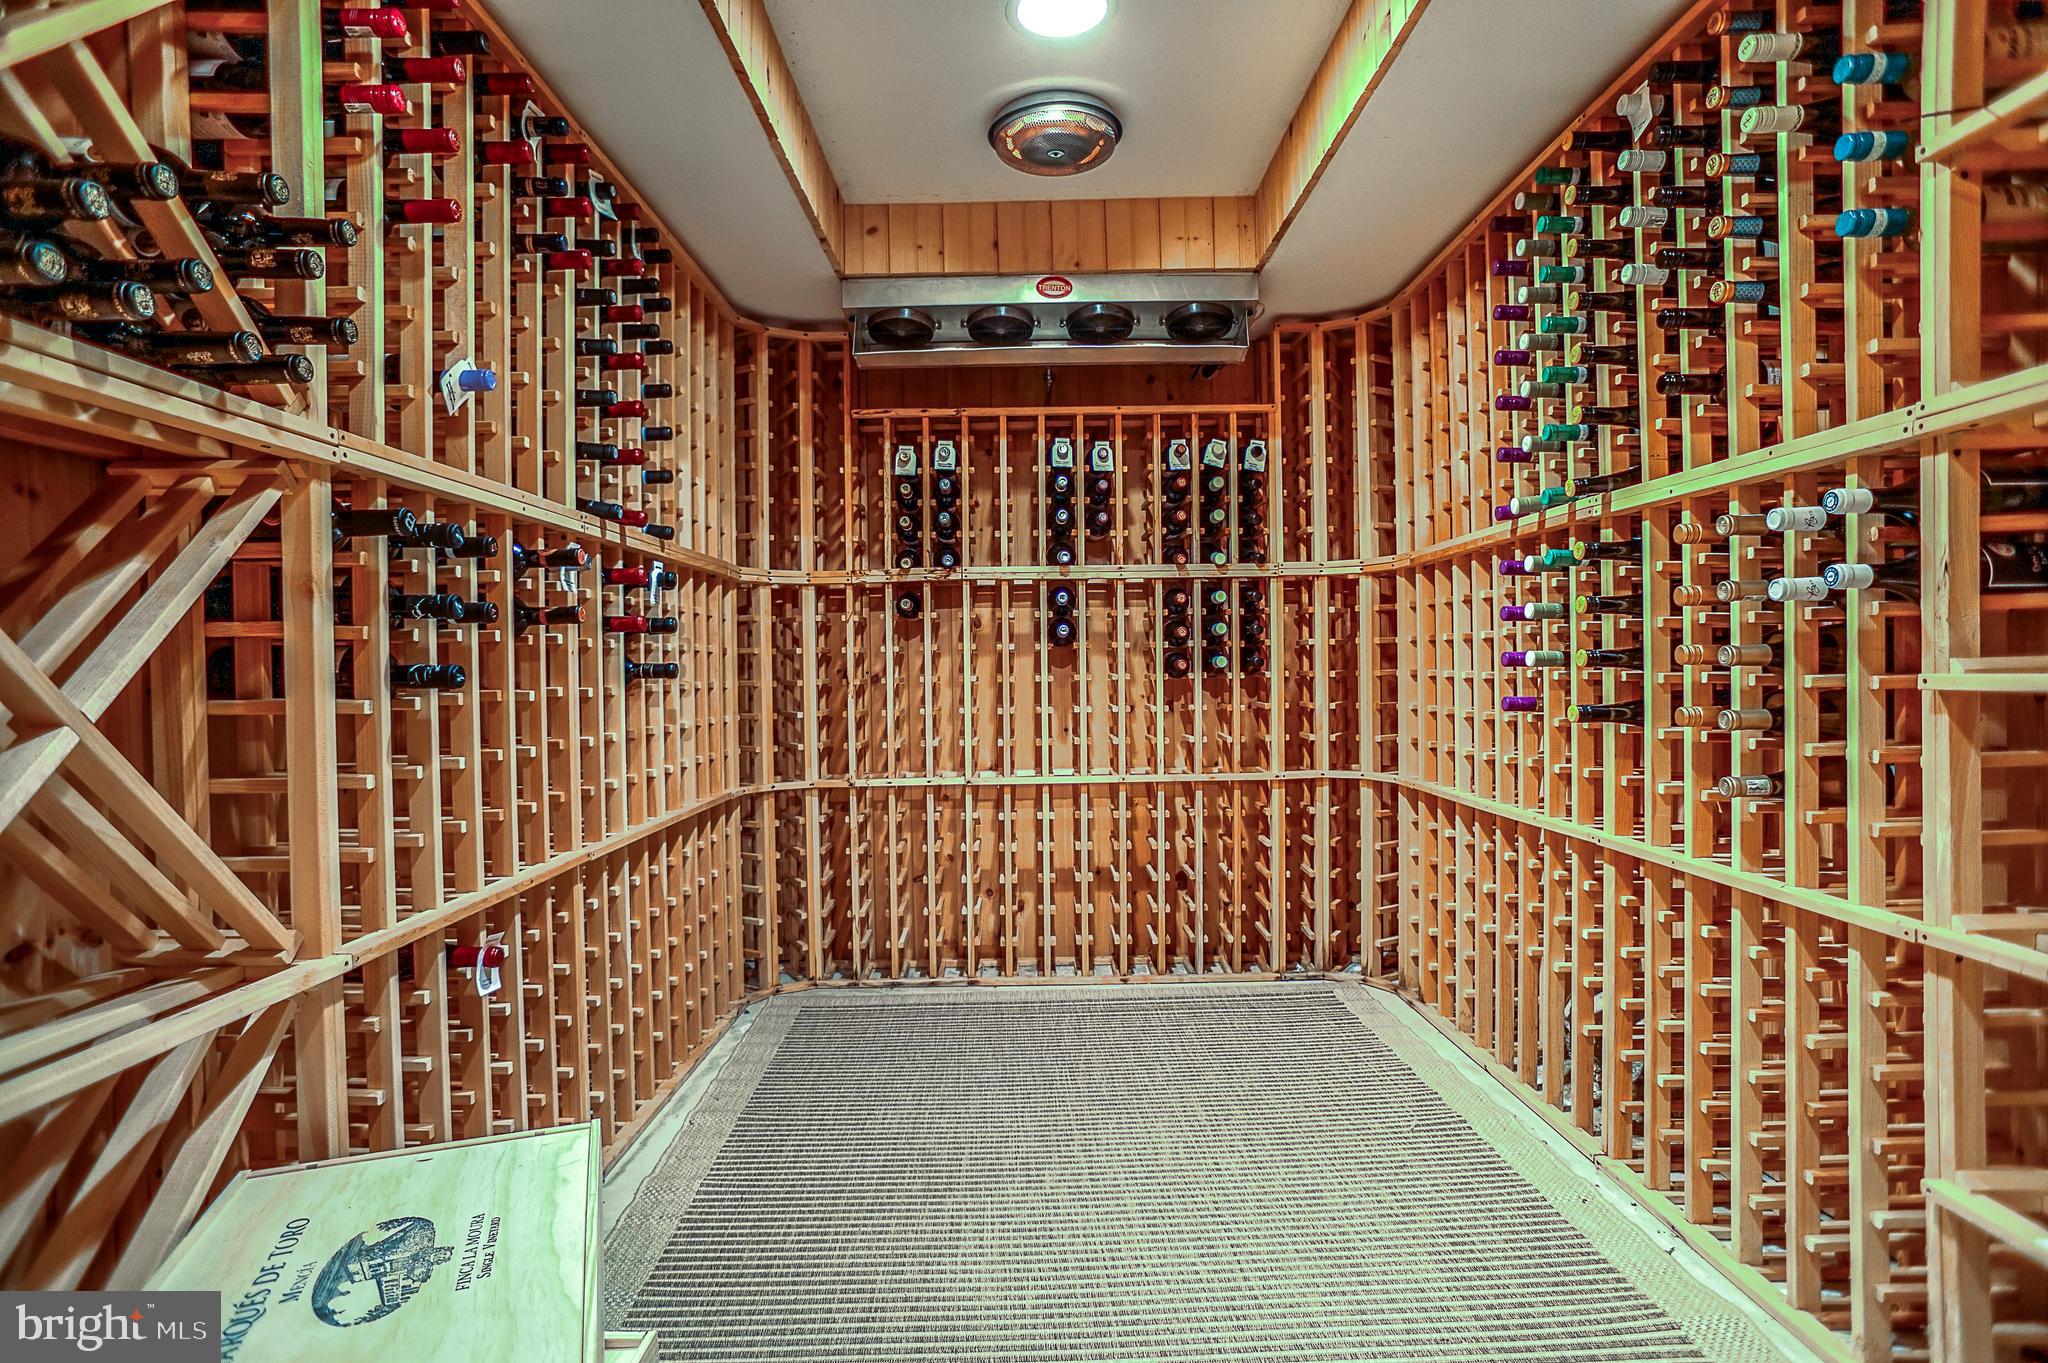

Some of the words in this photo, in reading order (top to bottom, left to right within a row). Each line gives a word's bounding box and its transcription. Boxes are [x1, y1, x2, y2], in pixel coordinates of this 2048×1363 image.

[267, 1217, 310, 1261] TORO
[465, 1212, 485, 1246] MOURA
[462, 1246, 478, 1260] LA
[252, 1261, 286, 1287] DE
[455, 1260, 475, 1291] FINCA
[221, 1288, 271, 1361] ARQUÉS
